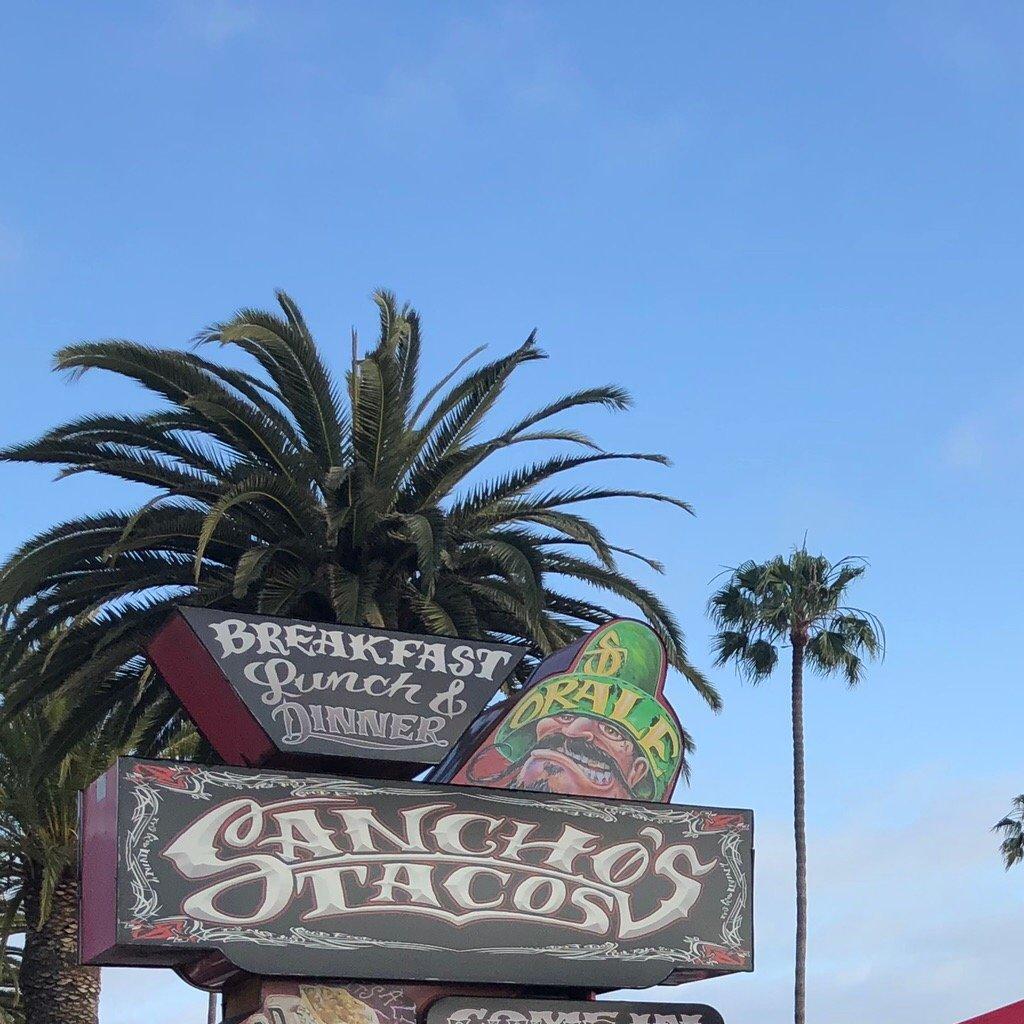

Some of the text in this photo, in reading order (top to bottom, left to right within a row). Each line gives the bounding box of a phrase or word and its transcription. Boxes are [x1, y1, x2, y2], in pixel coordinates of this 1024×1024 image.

[208, 618, 511, 681] BREAKFAST
[243, 658, 467, 719] Lunch &
[271, 698, 449, 747] DINNER
[162, 797, 718, 939] SANCHO'S
[294, 861, 614, 935] TACOS
